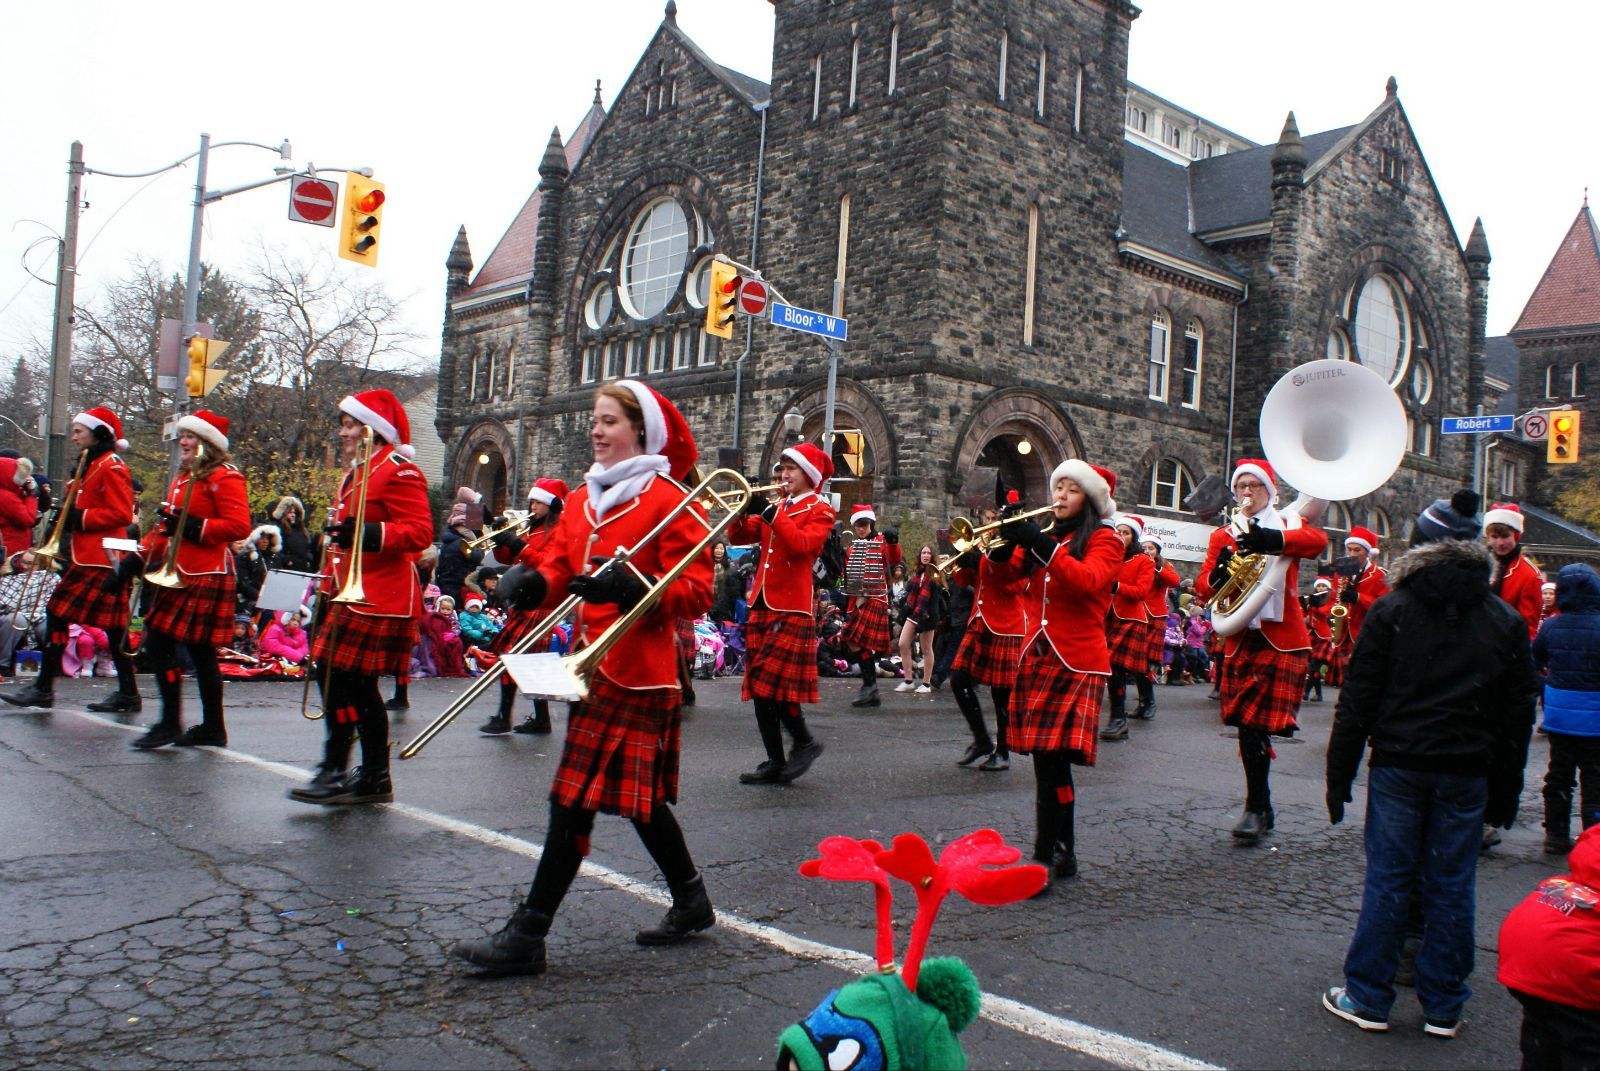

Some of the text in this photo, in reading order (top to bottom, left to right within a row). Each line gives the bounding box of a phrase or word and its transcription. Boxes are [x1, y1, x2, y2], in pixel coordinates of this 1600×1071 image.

[784, 307, 813, 327] Bloor
[826, 317, 836, 332] W
[1305, 368, 1345, 384] JUPITER
[1456, 418, 1491, 429] Robert
[1147, 526, 1158, 534] this
[1175, 542, 1194, 551] climate
[1194, 544, 1207, 553] chan
